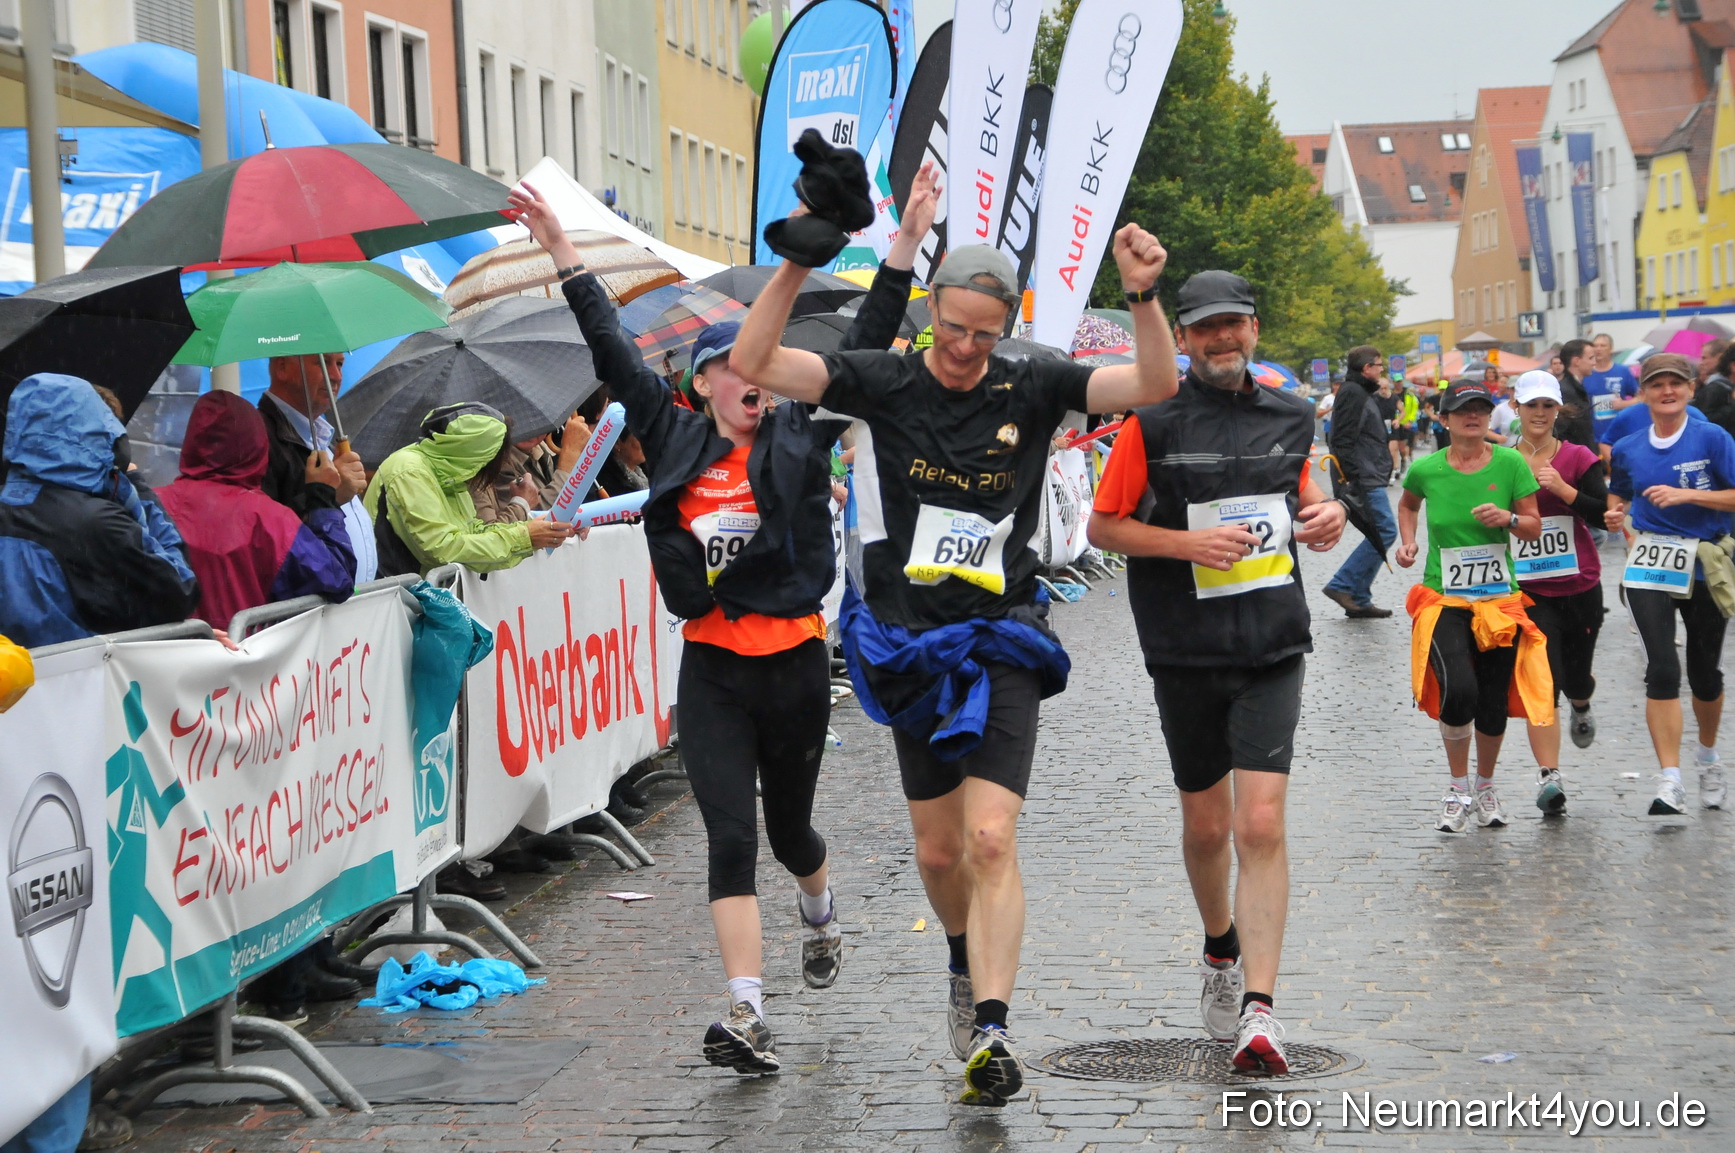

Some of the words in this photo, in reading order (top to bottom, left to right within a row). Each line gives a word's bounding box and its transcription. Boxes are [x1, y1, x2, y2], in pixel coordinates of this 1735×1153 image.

[796, 55, 861, 103] maxi
[980, 64, 1005, 158] BKK
[832, 119, 854, 145] dsl
[975, 168, 995, 244] udi
[1058, 204, 1093, 292] Audi
[1080, 120, 1114, 196] BKK
[556, 488, 575, 510] TUI
[568, 418, 614, 489] ReiseCenter
[909, 458, 970, 491] Relay
[1219, 502, 1258, 516] BOCK
[933, 535, 992, 568] 690
[1517, 531, 1569, 558] 2909
[1633, 544, 1689, 571] 2976
[1449, 560, 1504, 587] 2773
[1529, 560, 1561, 571] Nadine
[1644, 571, 1667, 582] Doris
[496, 578, 645, 778] Oberbank
[14, 863, 84, 918] NISSAN
